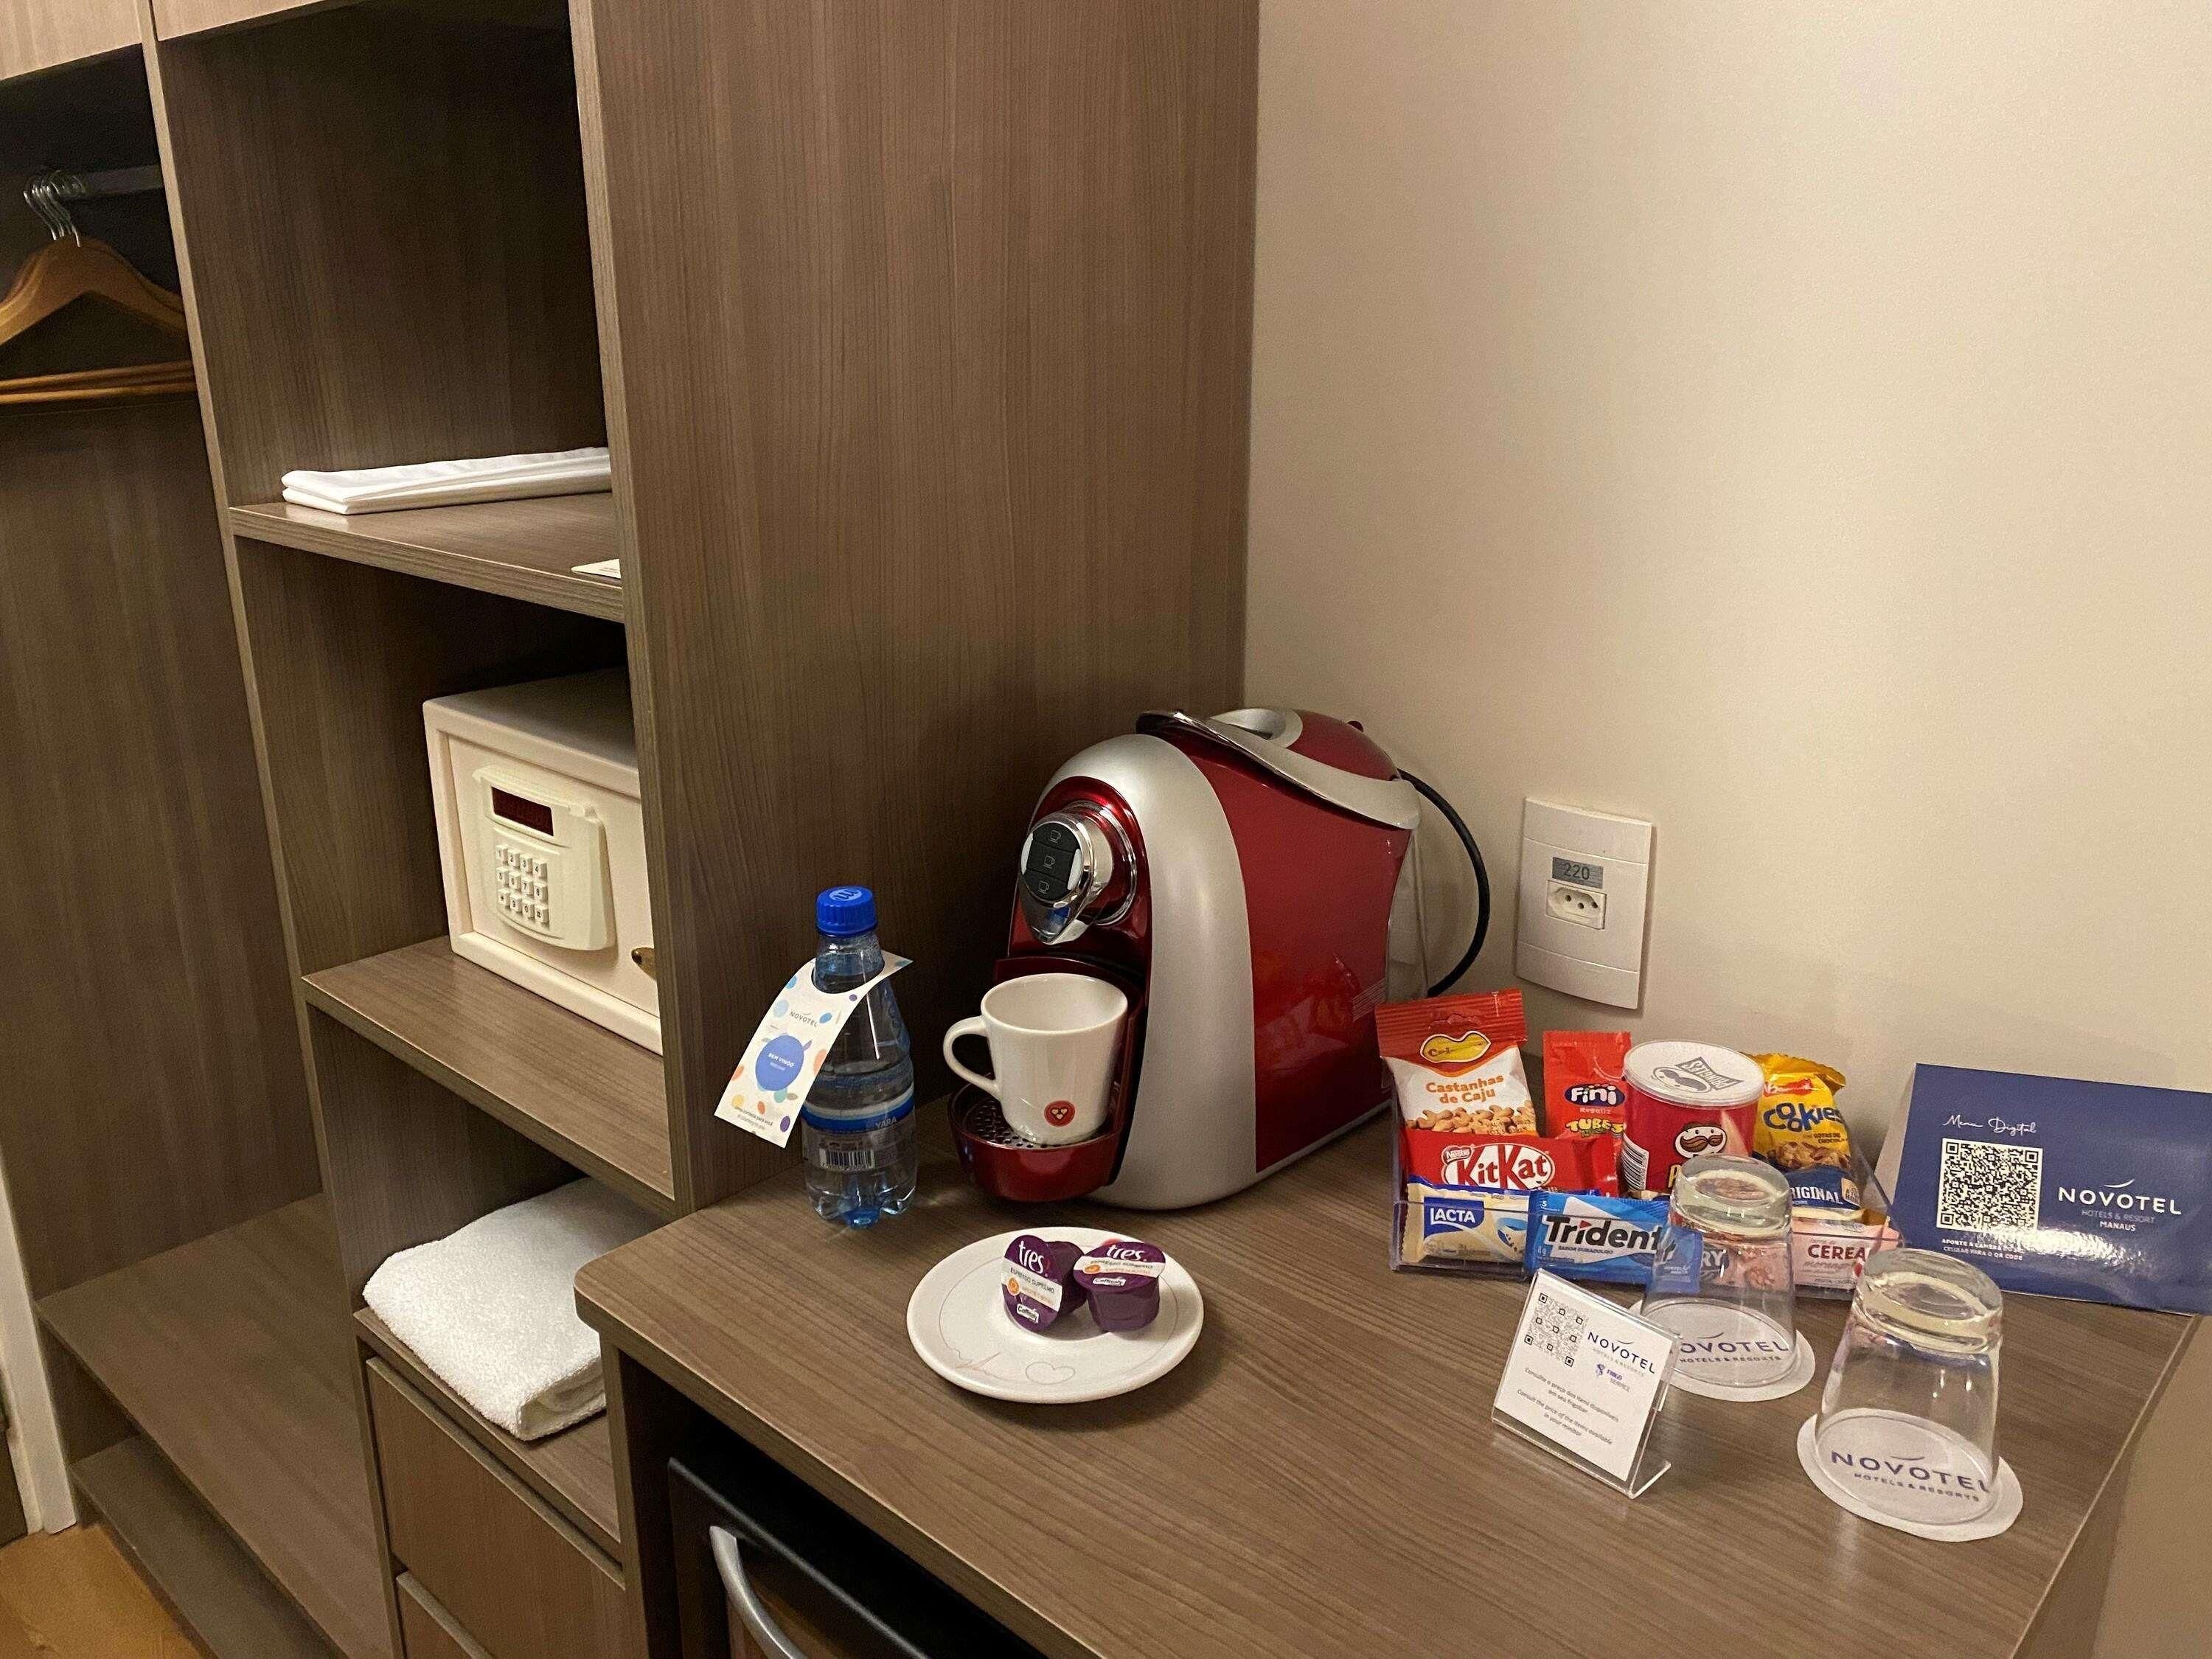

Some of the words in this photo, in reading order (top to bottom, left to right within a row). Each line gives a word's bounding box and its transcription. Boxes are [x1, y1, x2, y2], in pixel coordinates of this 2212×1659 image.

[1563, 863, 1590, 880] 220
[789, 1011, 818, 1027] NOVOTEL
[1425, 1074, 1504, 1093] Castanhas
[1439, 1093, 1458, 1104] de
[1462, 1089, 1495, 1102] Caju
[1571, 1087, 1616, 1105] Fini
[1565, 1118, 1624, 1133] TUBES
[1988, 1117, 2037, 1136] Digital
[1457, 1144, 1547, 1189] KitKat
[1791, 1186, 1843, 1203] RIGINAL
[2058, 1186, 2182, 1215] NOVOTEL
[1430, 1208, 1475, 1225] LACTA
[2081, 1210, 2112, 1219] HOTELS
[1546, 1216, 1662, 1251] Trident
[2100, 1220, 2136, 1231] MANAUS
[1808, 1245, 1865, 1262] CEREA
[1588, 1332, 1655, 1374] NOVOTEL
[1680, 1341, 1789, 1353] OVOTEL
[1832, 1450, 1990, 1493] NOVOTEL
[1854, 1473, 1904, 1486] HOTELS
